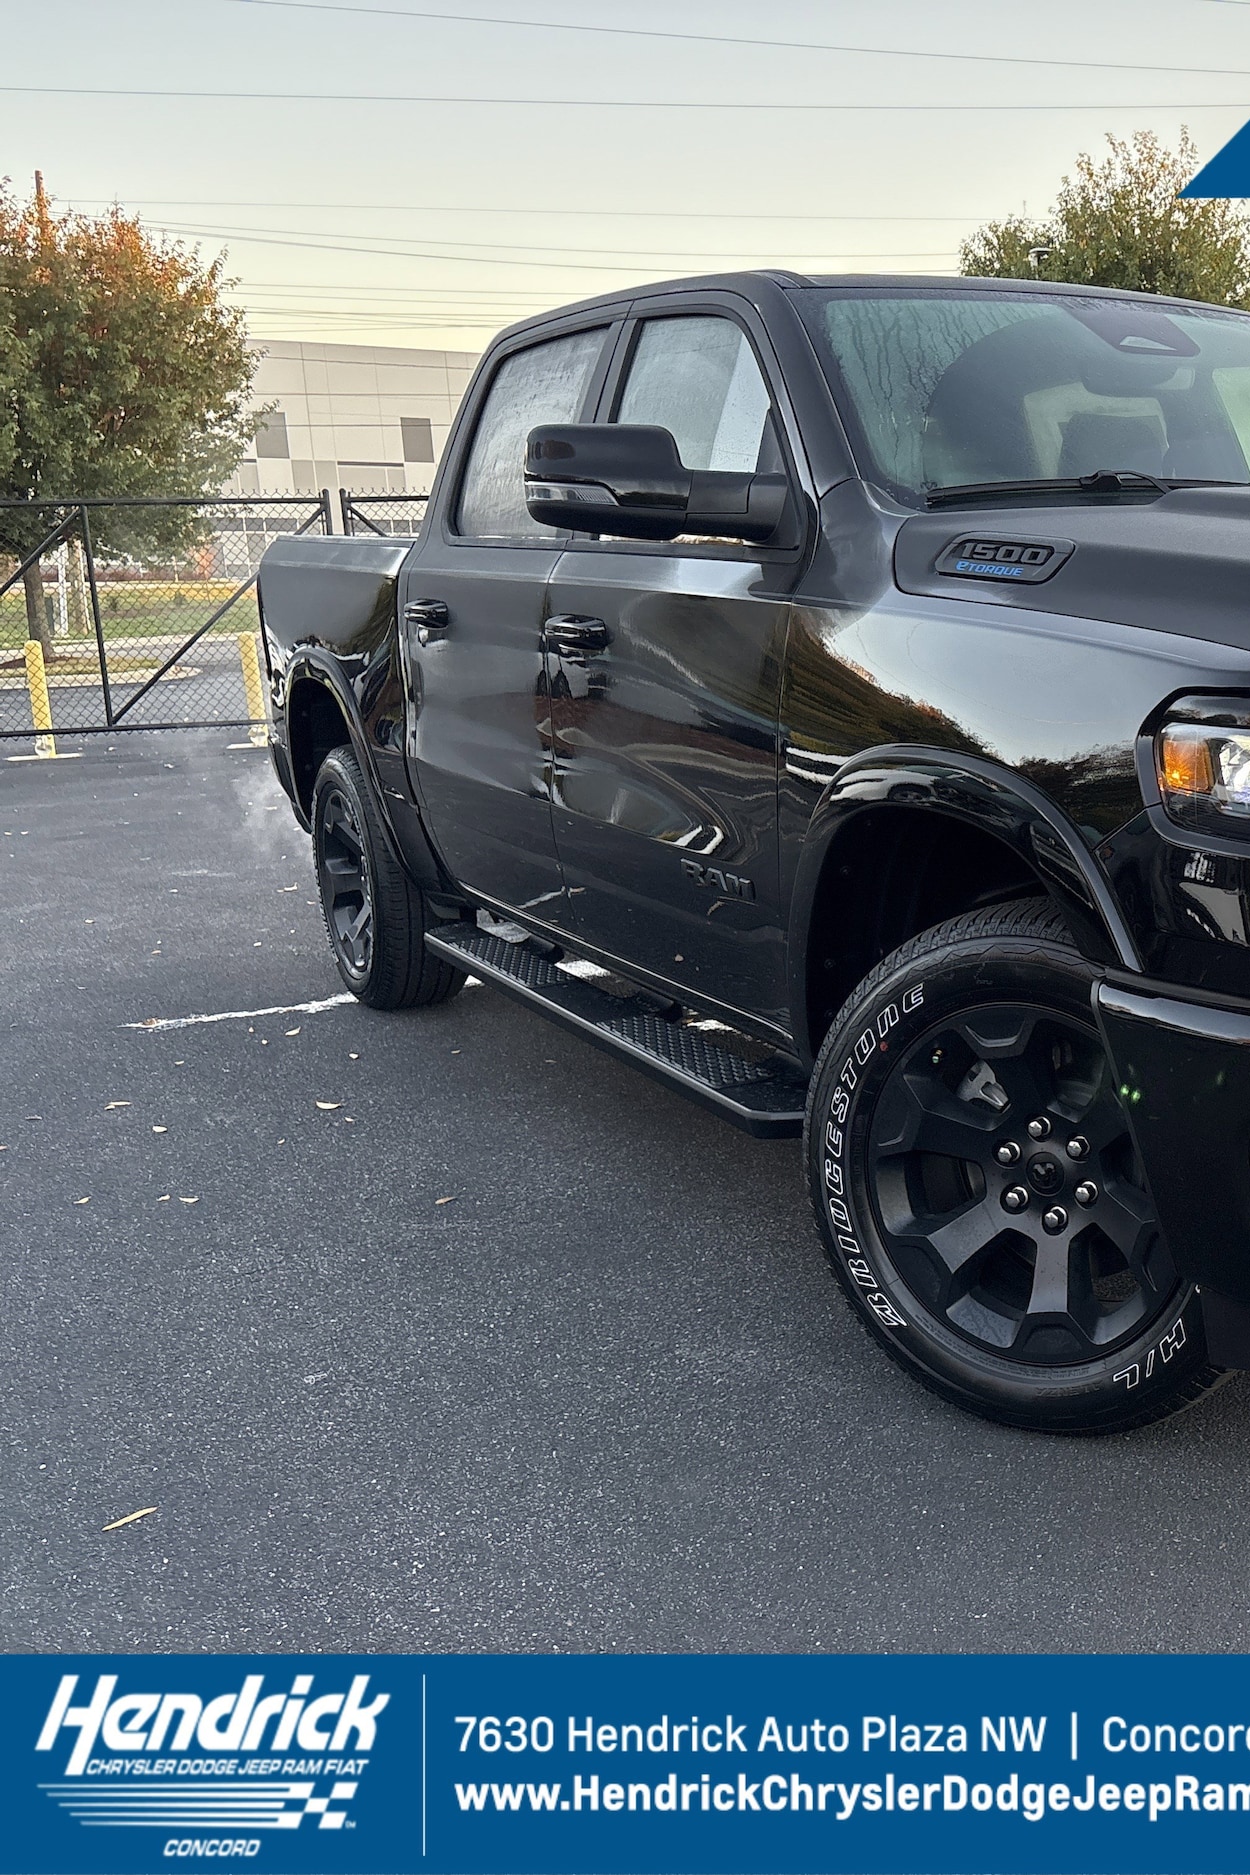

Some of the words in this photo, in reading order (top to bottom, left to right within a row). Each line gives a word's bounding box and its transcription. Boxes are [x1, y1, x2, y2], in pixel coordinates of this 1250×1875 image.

[959, 542, 1051, 565] 1500
[680, 857, 757, 900] RAM
[824, 982, 926, 1327] BRIDGESTONE
